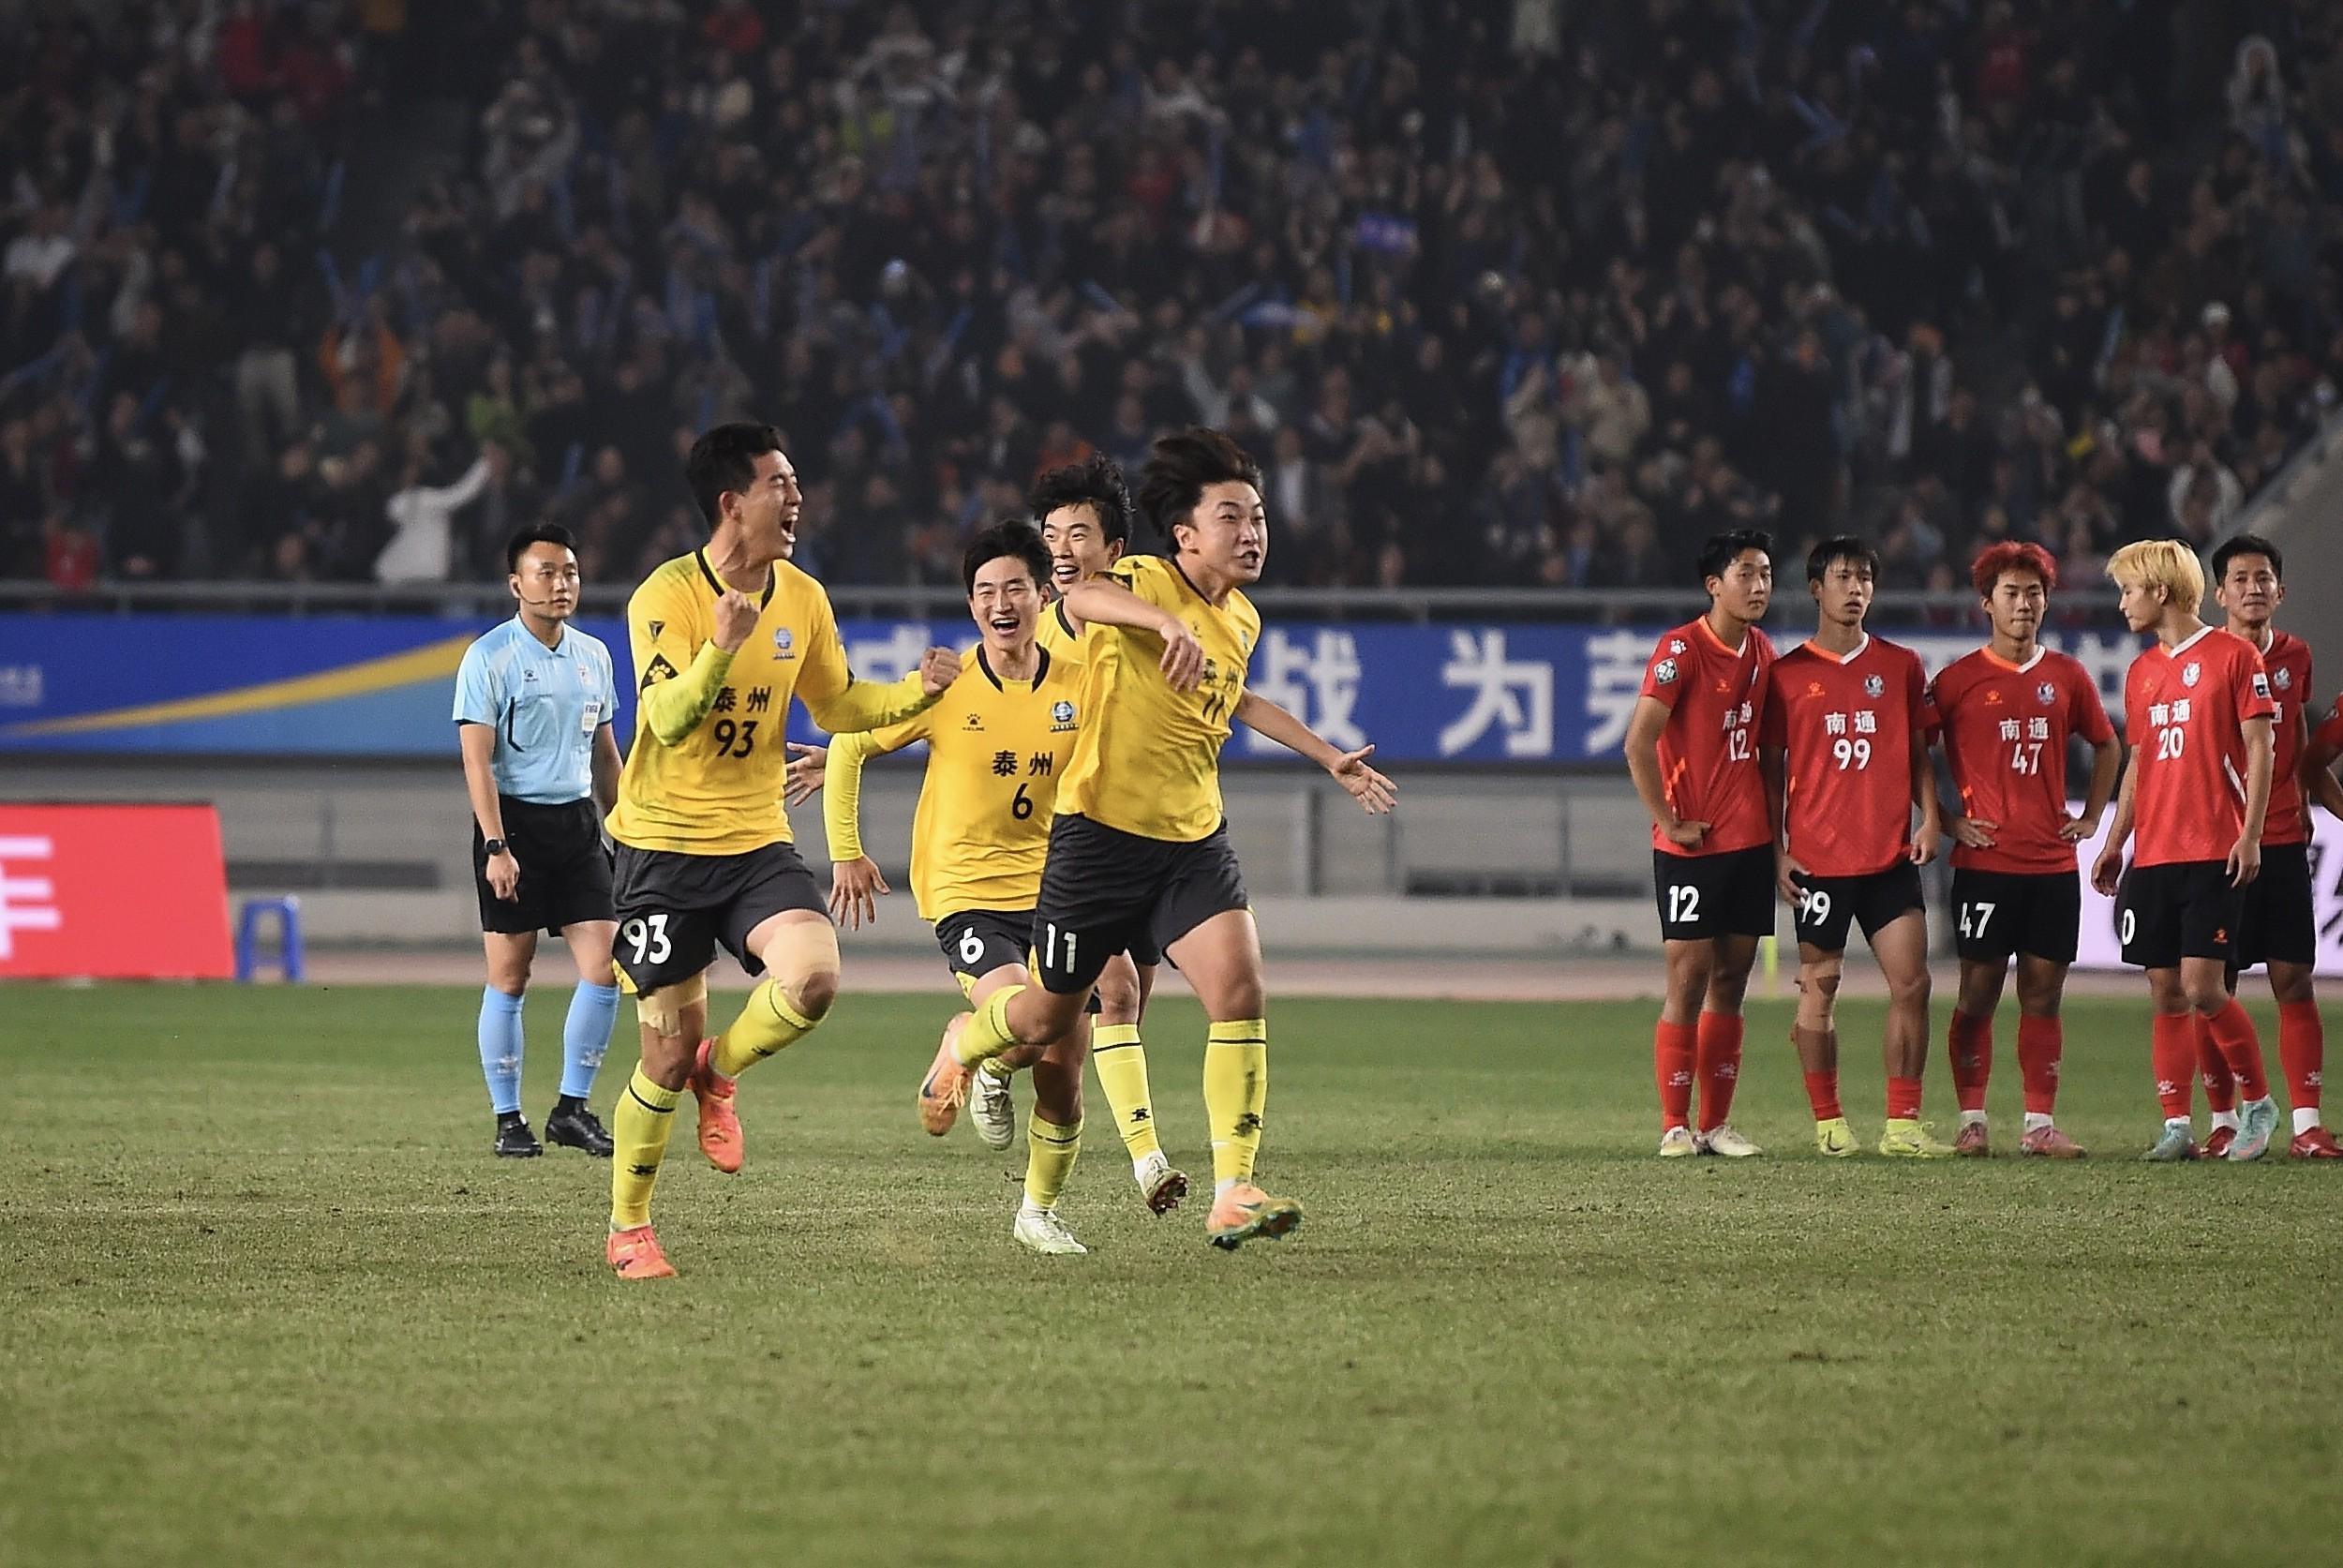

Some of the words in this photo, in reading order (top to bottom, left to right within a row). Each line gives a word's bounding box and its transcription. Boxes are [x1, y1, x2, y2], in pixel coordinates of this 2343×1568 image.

[712, 685, 771, 712] 泰州
[1202, 692, 1225, 724] 11
[2148, 698, 2191, 727] 南通
[714, 719, 758, 758] 93
[1825, 709, 1877, 736] 南通
[1998, 716, 2050, 741] 南通
[1729, 728, 1751, 762] 12
[1833, 739, 1872, 771] 99
[2011, 743, 2043, 775] 47
[2157, 726, 2186, 761] 20
[992, 750, 1053, 777] 泰州
[1012, 783, 1034, 820] 6
[1669, 885, 1700, 923] 12
[1959, 902, 1996, 939] 47
[622, 914, 672, 965] 93
[959, 926, 985, 964] 6
[1046, 922, 1077, 974] 11
